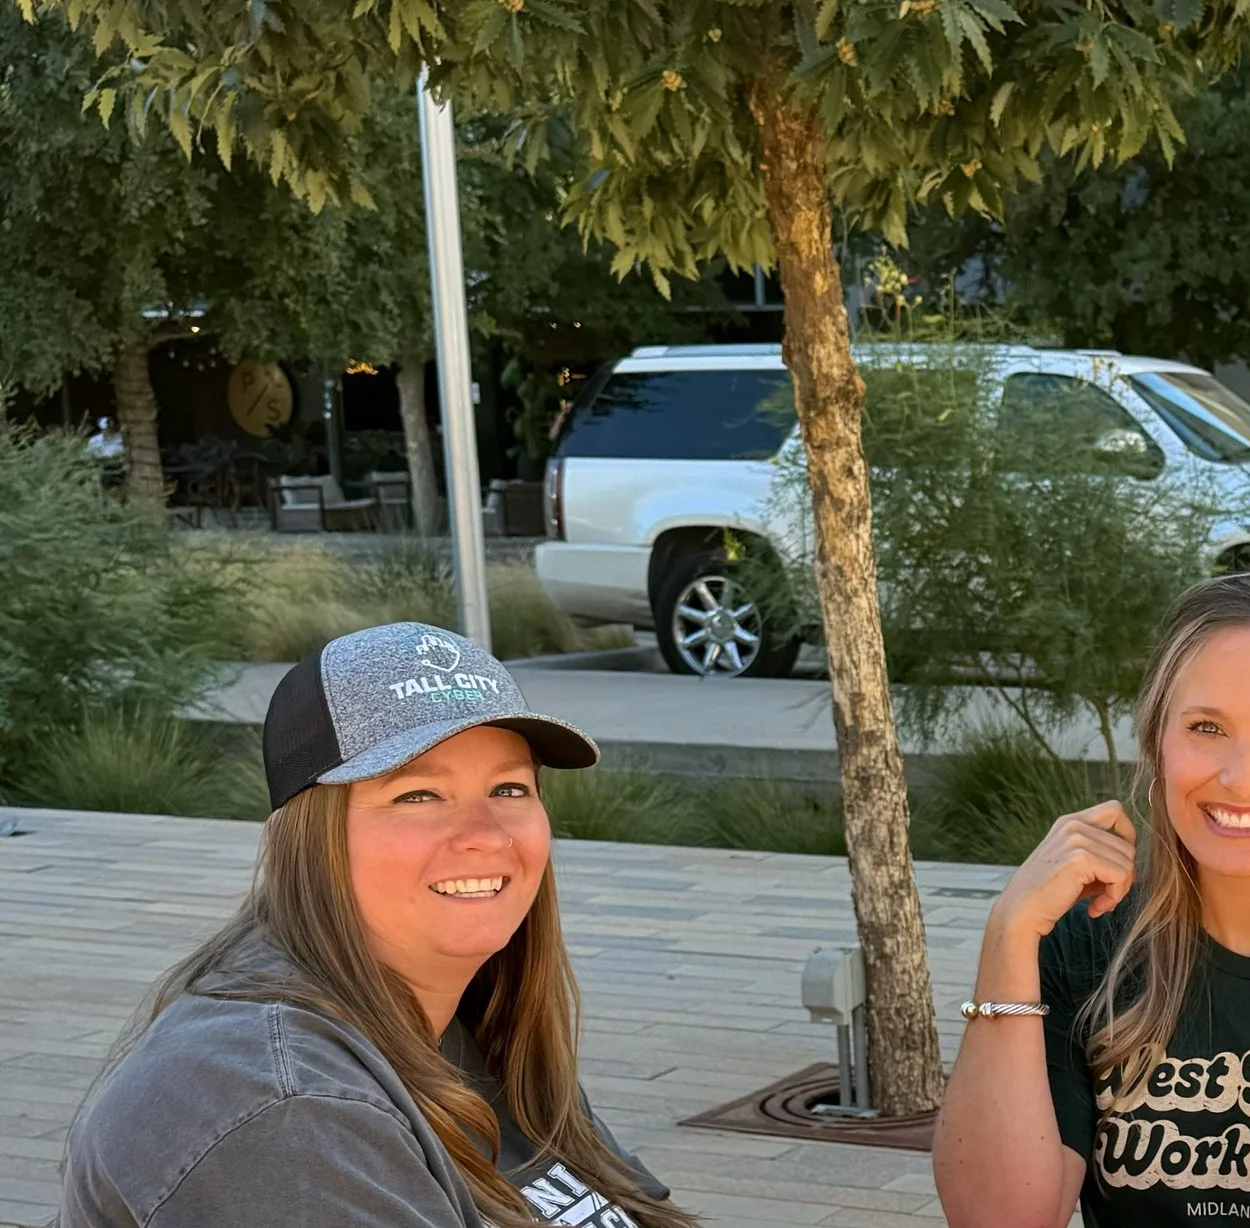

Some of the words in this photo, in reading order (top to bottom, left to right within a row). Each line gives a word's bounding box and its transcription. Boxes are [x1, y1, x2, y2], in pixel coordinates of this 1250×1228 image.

[389, 675, 451, 700] TALL
[455, 673, 500, 694] CITY
[431, 688, 484, 702] CYBER
